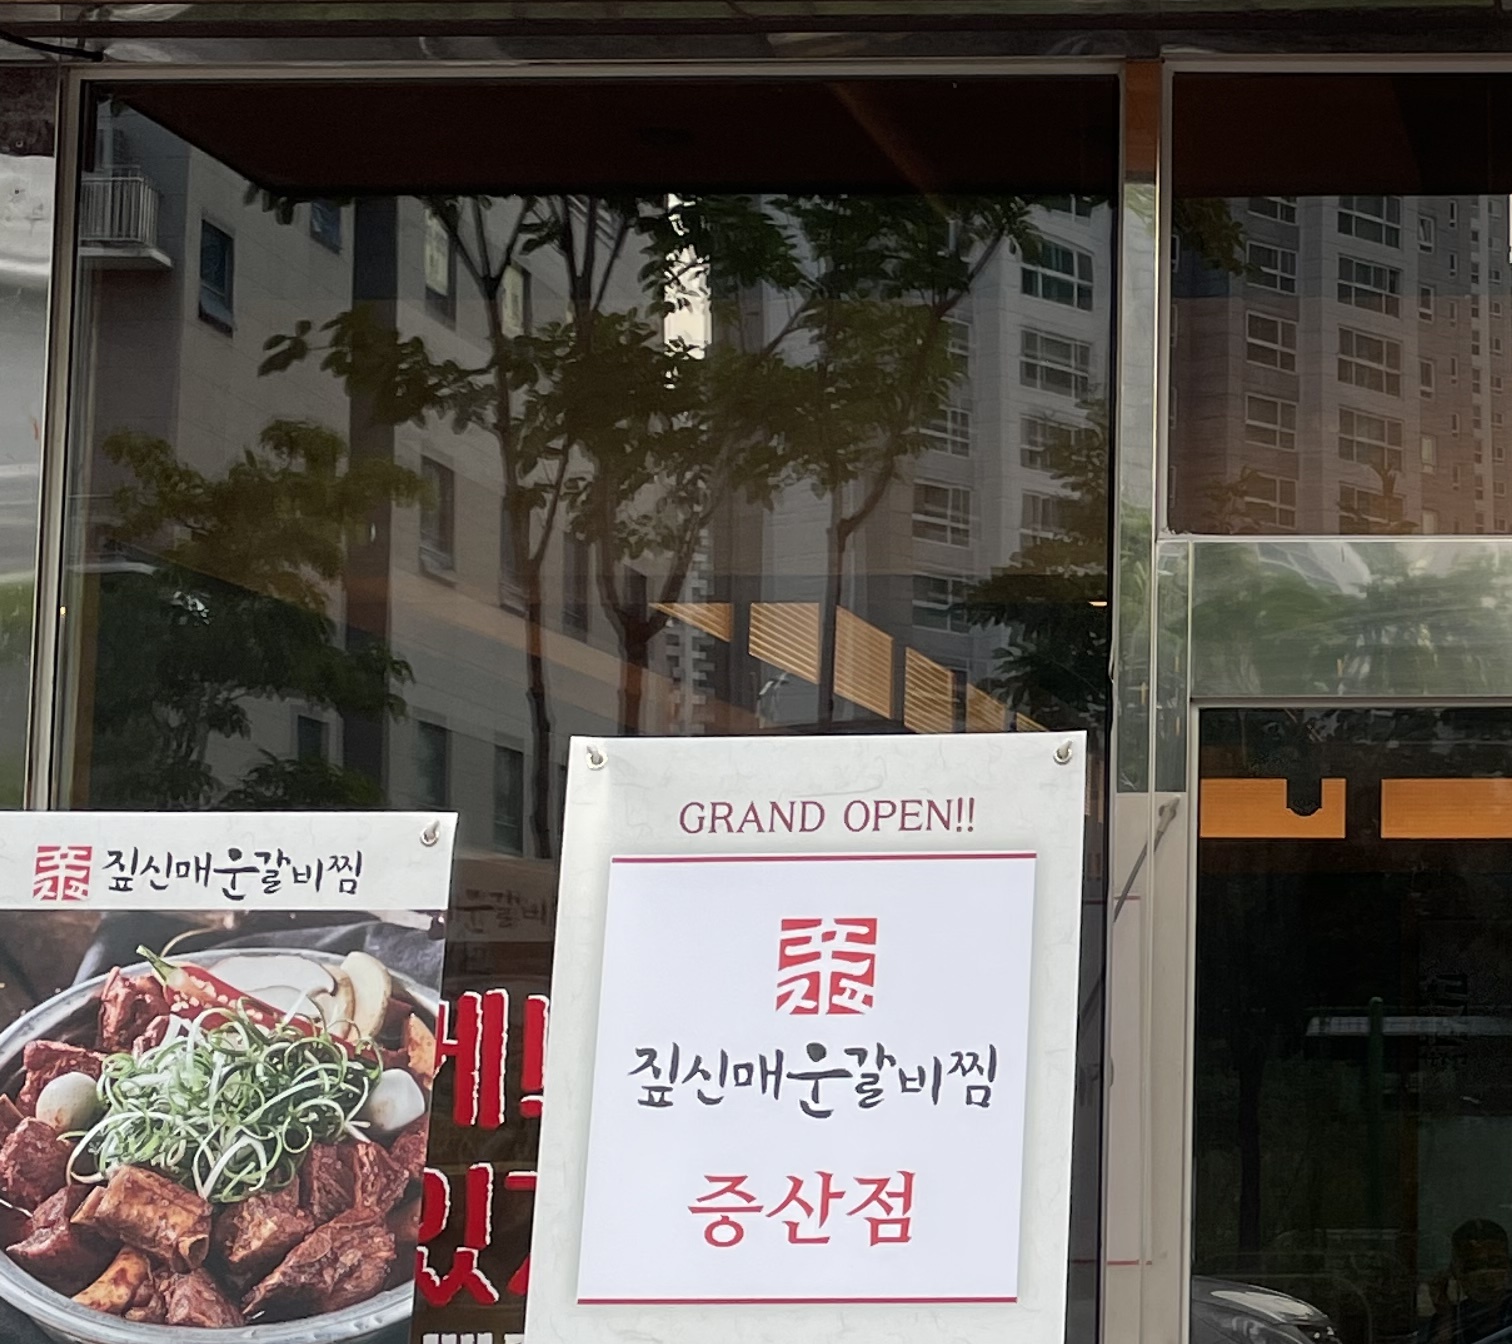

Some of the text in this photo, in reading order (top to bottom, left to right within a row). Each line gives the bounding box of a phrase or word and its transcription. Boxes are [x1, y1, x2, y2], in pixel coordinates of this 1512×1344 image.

[679, 797, 976, 834] GRAND OPEN!!
[105, 846, 363, 901] 짚신매운갈비찜
[628, 1042, 998, 1119] 짚신매운갈비찜
[687, 1170, 916, 1248] 증산점
